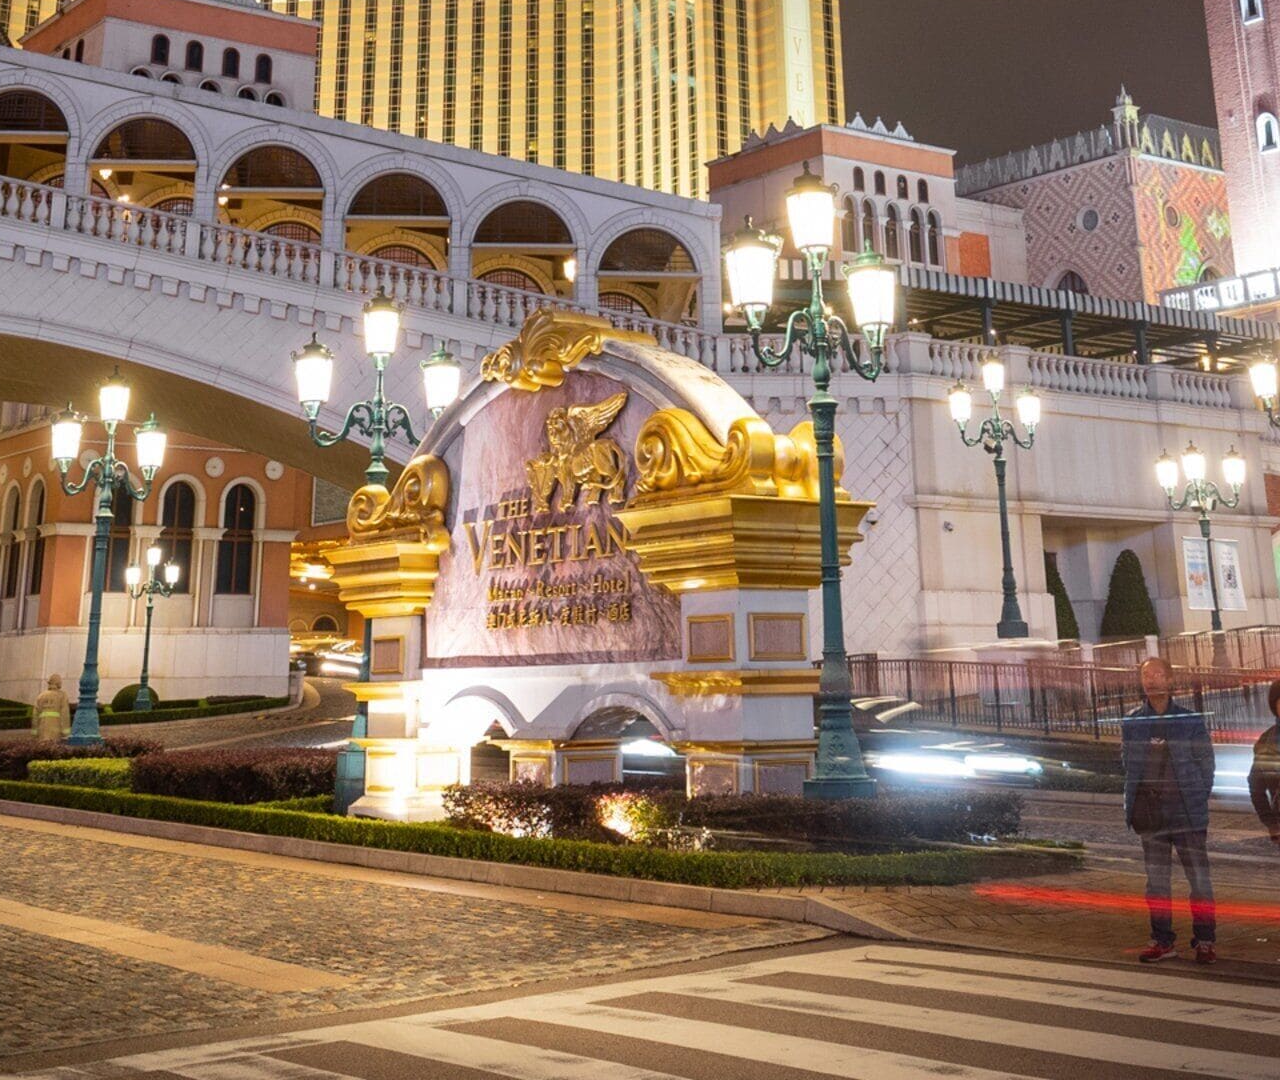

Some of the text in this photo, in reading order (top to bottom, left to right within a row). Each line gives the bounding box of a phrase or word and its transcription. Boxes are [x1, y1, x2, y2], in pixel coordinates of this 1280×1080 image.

[498, 499, 529, 520] THE
[463, 520, 627, 576] VENETIAN
[536, 580, 577, 598] Resort
[590, 570, 631, 596] Hotel
